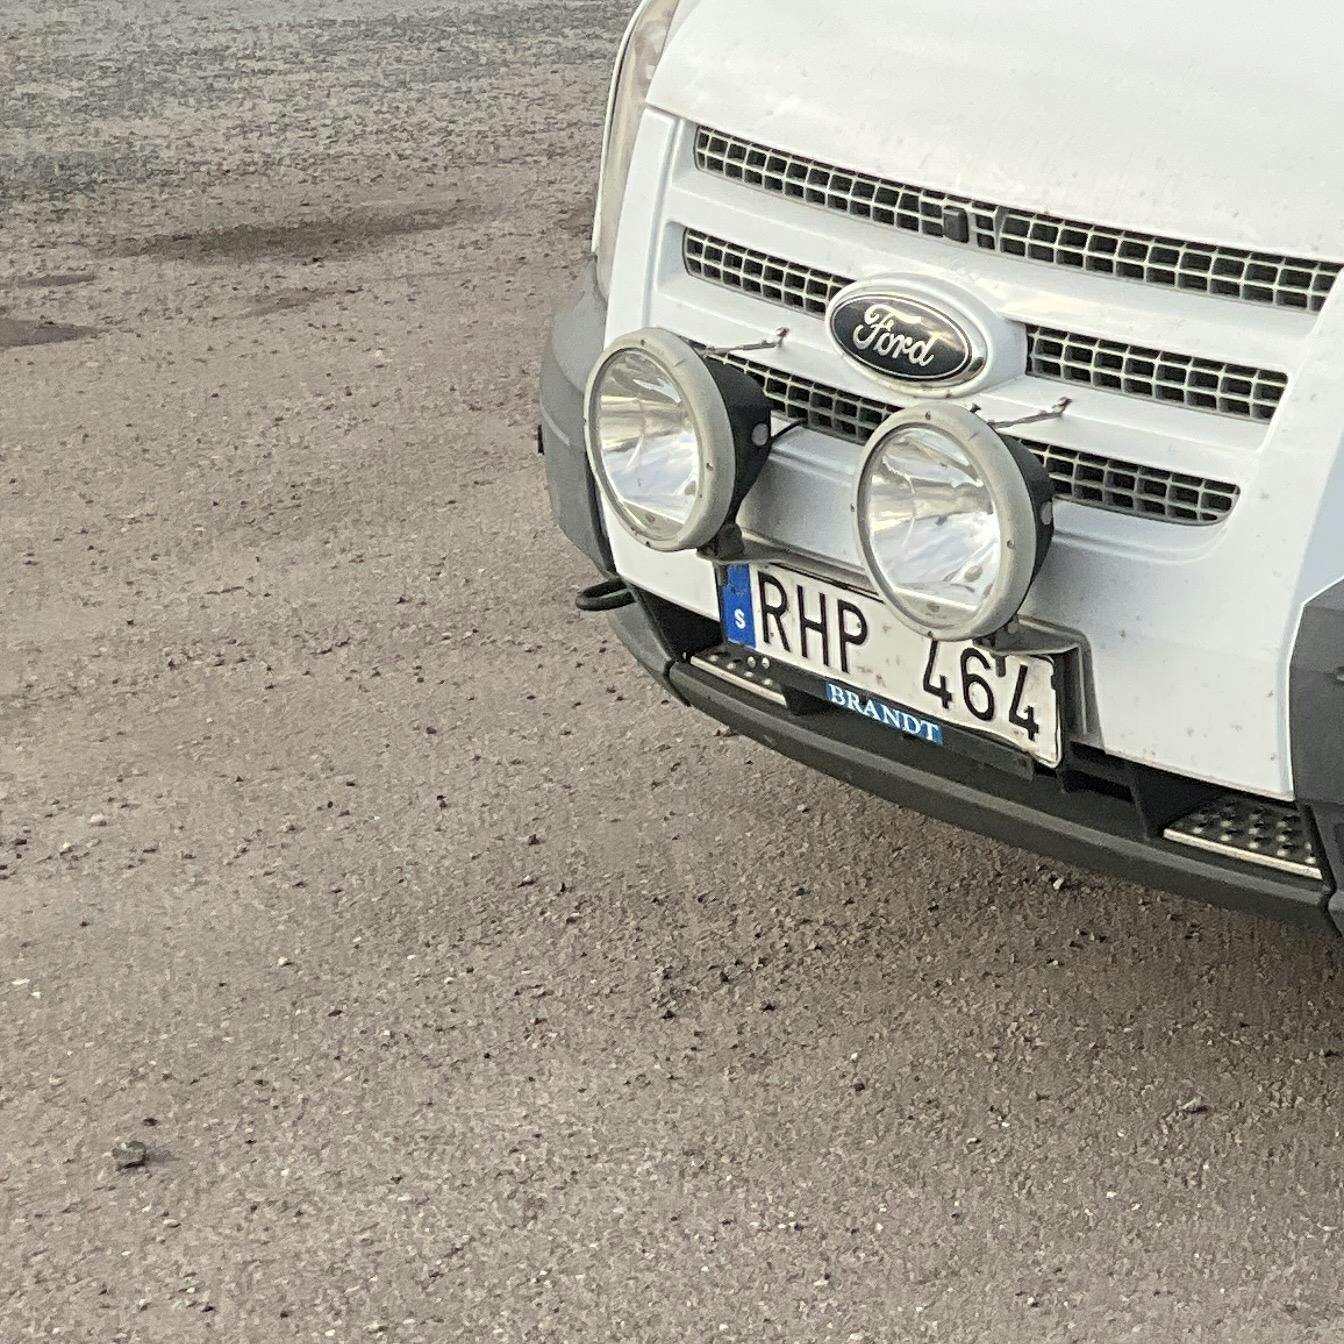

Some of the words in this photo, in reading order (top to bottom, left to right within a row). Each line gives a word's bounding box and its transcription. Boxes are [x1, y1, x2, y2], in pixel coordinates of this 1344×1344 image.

[852, 303, 941, 367] Ford
[734, 610, 747, 630] S
[757, 570, 869, 674] RHP
[922, 639, 1040, 741] 464
[828, 682, 940, 744] BRANDT
